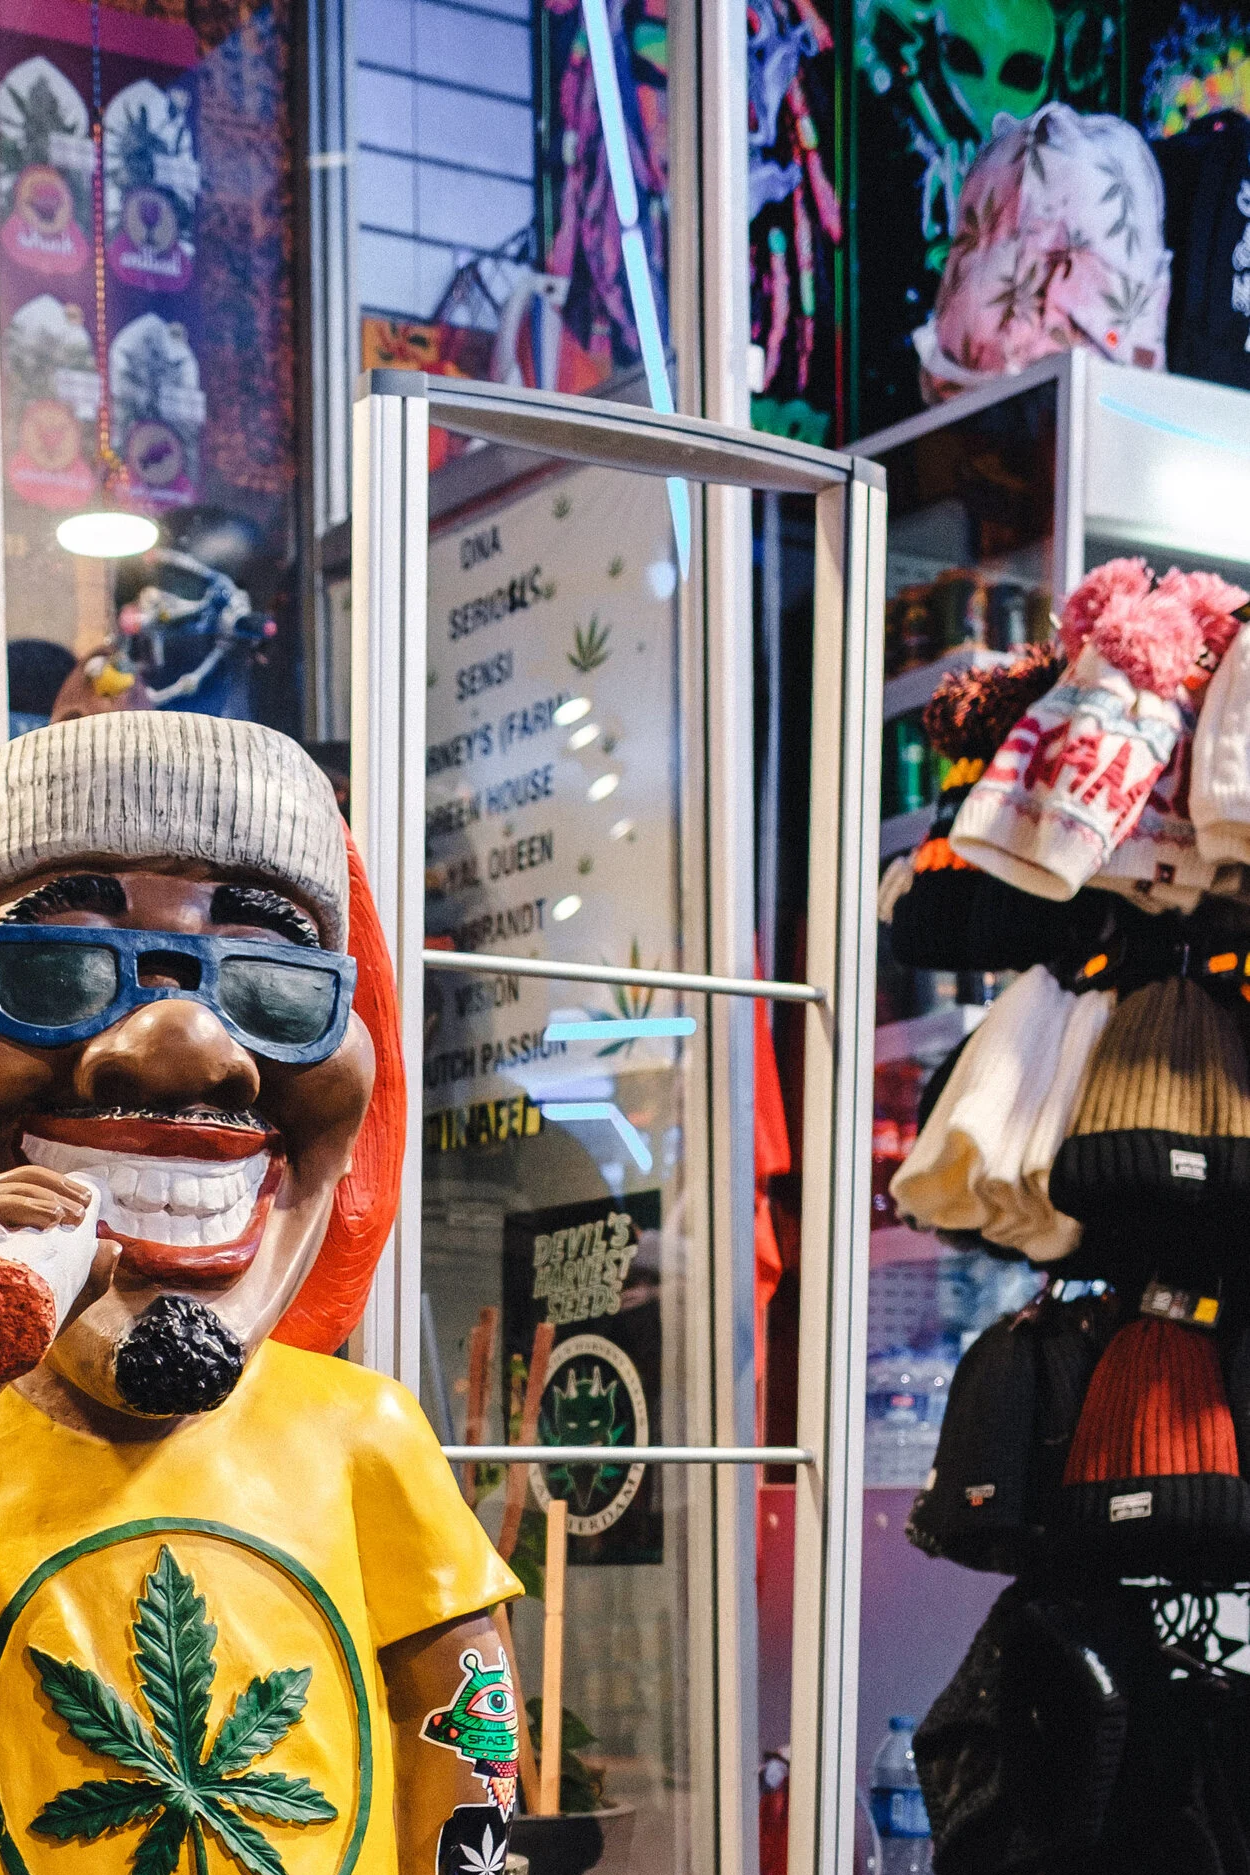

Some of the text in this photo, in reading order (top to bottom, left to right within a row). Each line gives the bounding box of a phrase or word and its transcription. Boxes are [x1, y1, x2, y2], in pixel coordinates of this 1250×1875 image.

[455, 650, 514, 701] SENSI
[486, 763, 554, 815] HOUSE
[489, 830, 553, 881] QUEEN
[533, 1211, 632, 1267] DEVIL'S
[533, 1244, 638, 1299] HARVEST
[547, 1281, 622, 1325] SEEDS
[468, 1734, 507, 1746] SPACE
